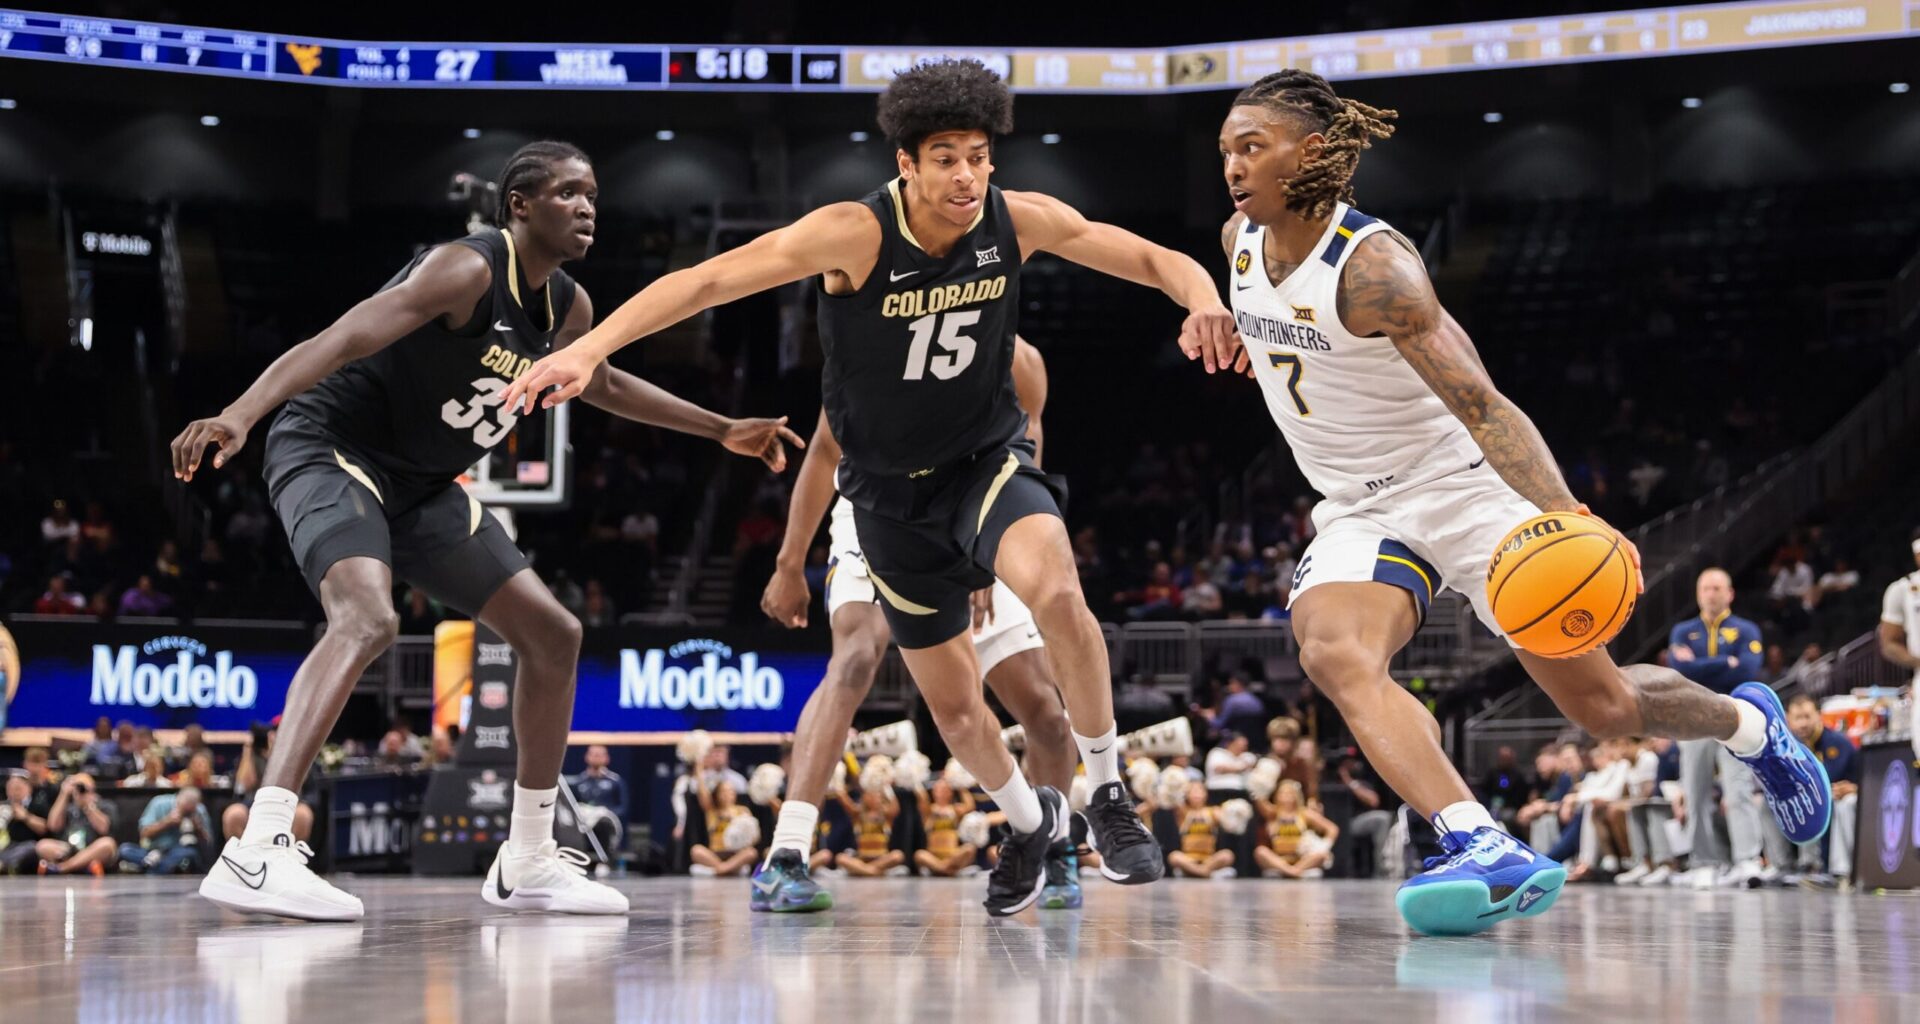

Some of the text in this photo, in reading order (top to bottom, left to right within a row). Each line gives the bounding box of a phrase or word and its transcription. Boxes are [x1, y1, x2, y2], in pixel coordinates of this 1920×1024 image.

[434, 49, 480, 81] 27
[695, 48, 768, 80] 5:18
[882, 275, 1007, 318] COLORADO
[902, 309, 982, 381] 15
[1236, 308, 1331, 351] MOUNTAINEERS
[480, 344, 536, 381] COLO
[1268, 352, 1310, 416] 7
[1486, 518, 1566, 583] Wilson
[90, 644, 258, 709] Modelo
[617, 648, 784, 710] Modelo
